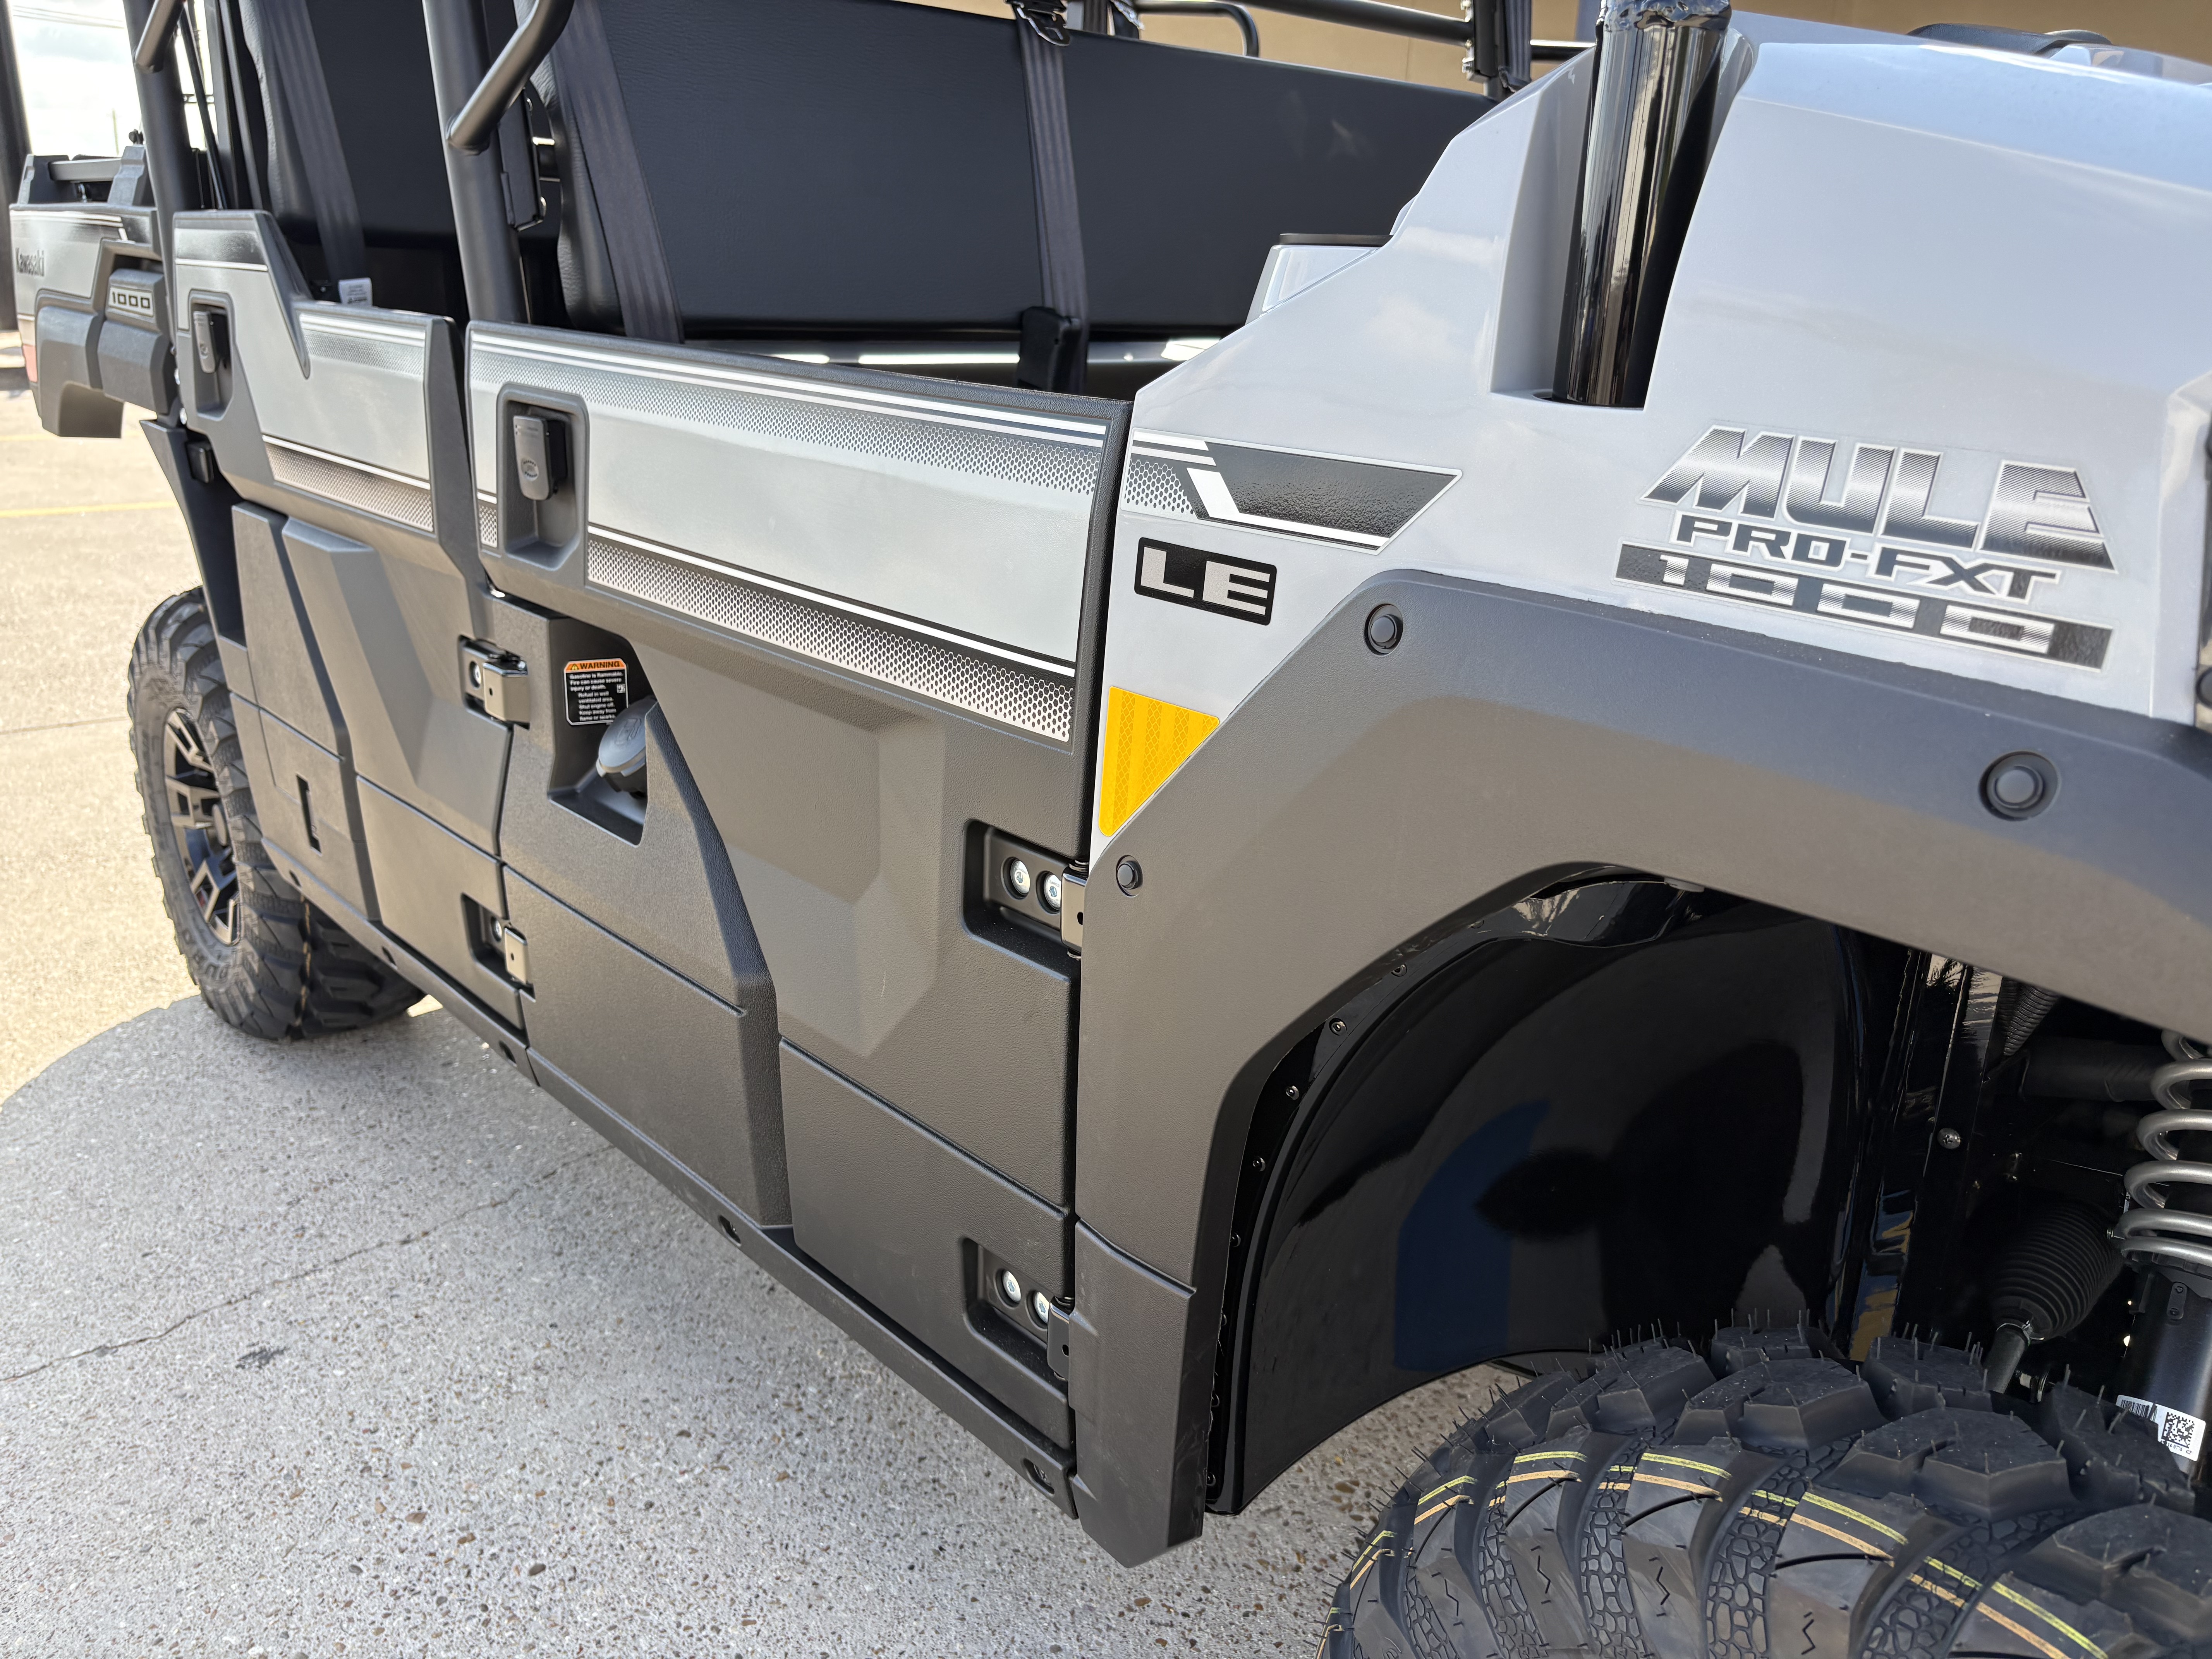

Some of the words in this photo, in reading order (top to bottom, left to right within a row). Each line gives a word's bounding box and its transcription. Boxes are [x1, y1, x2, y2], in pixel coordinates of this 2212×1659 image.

[112, 291, 150, 309] 1000
[1640, 424, 2117, 572] MULE
[1140, 546, 1271, 615] LE
[1674, 512, 2059, 603] PRO-FXT
[1660, 555, 2056, 654] 1000
[580, 661, 620, 669] WARNING
